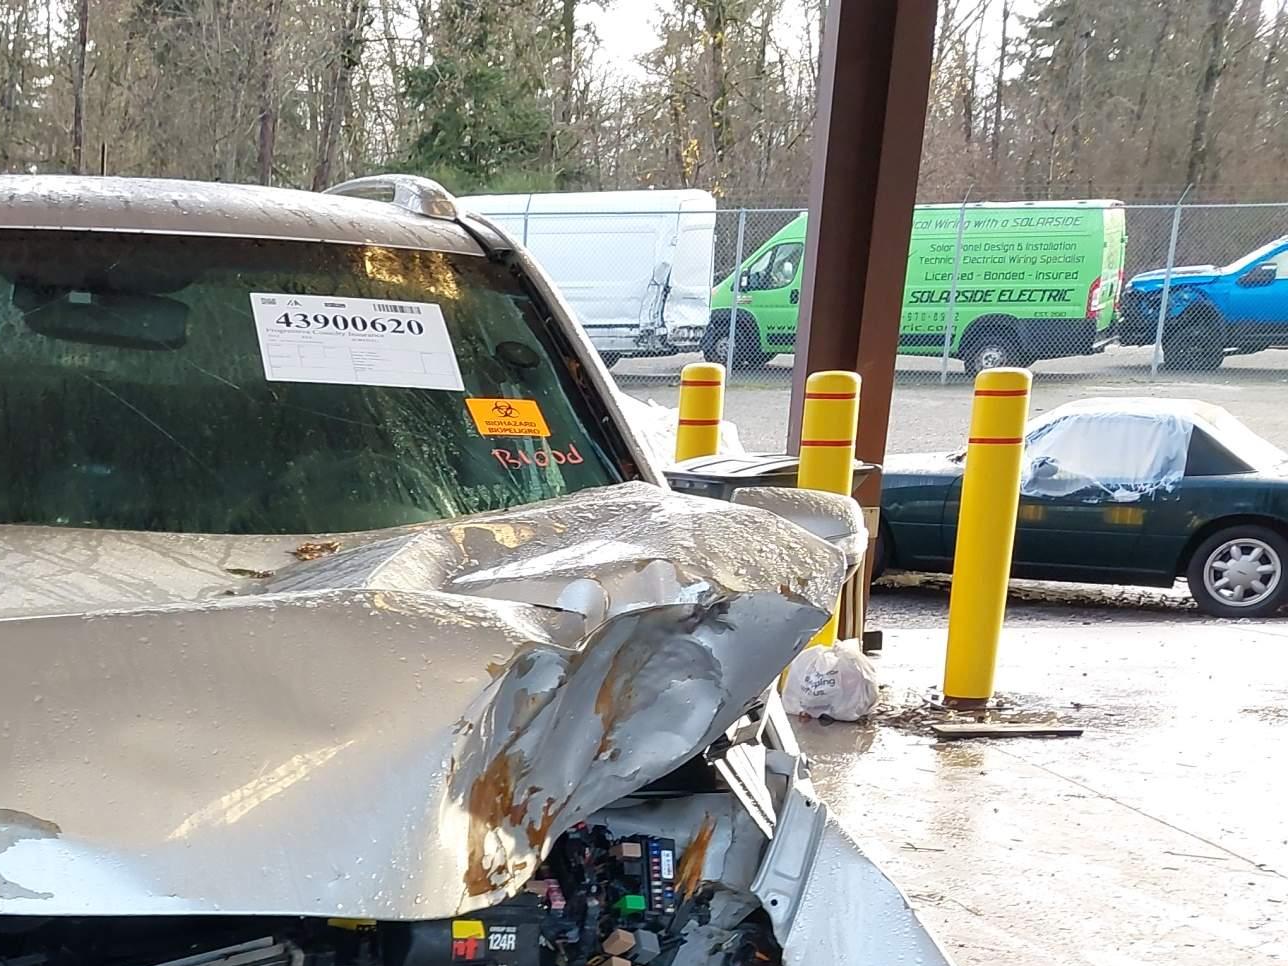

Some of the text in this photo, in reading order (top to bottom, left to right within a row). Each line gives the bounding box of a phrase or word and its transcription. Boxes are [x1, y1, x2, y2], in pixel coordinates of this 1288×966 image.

[974, 218, 999, 230] with
[1001, 219, 1009, 229] a
[1012, 216, 1083, 228] SOLARSIDE
[930, 243, 955, 253] Solar
[960, 242, 982, 252] anel
[984, 242, 1015, 253] Design
[1026, 241, 1077, 252] Installation
[919, 254, 1085, 266] Technic Electrical Wiring Specialist
[983, 270, 1025, 281] Bonded
[996, 288, 1075, 303] ELECTRIC
[276, 311, 424, 336] 43900620
[485, 420, 537, 428] BIOHAZARD
[488, 427, 540, 435] BIOPELIGRO
[491, 443, 584, 470] Blood
[488, 933, 517, 951] 124R
